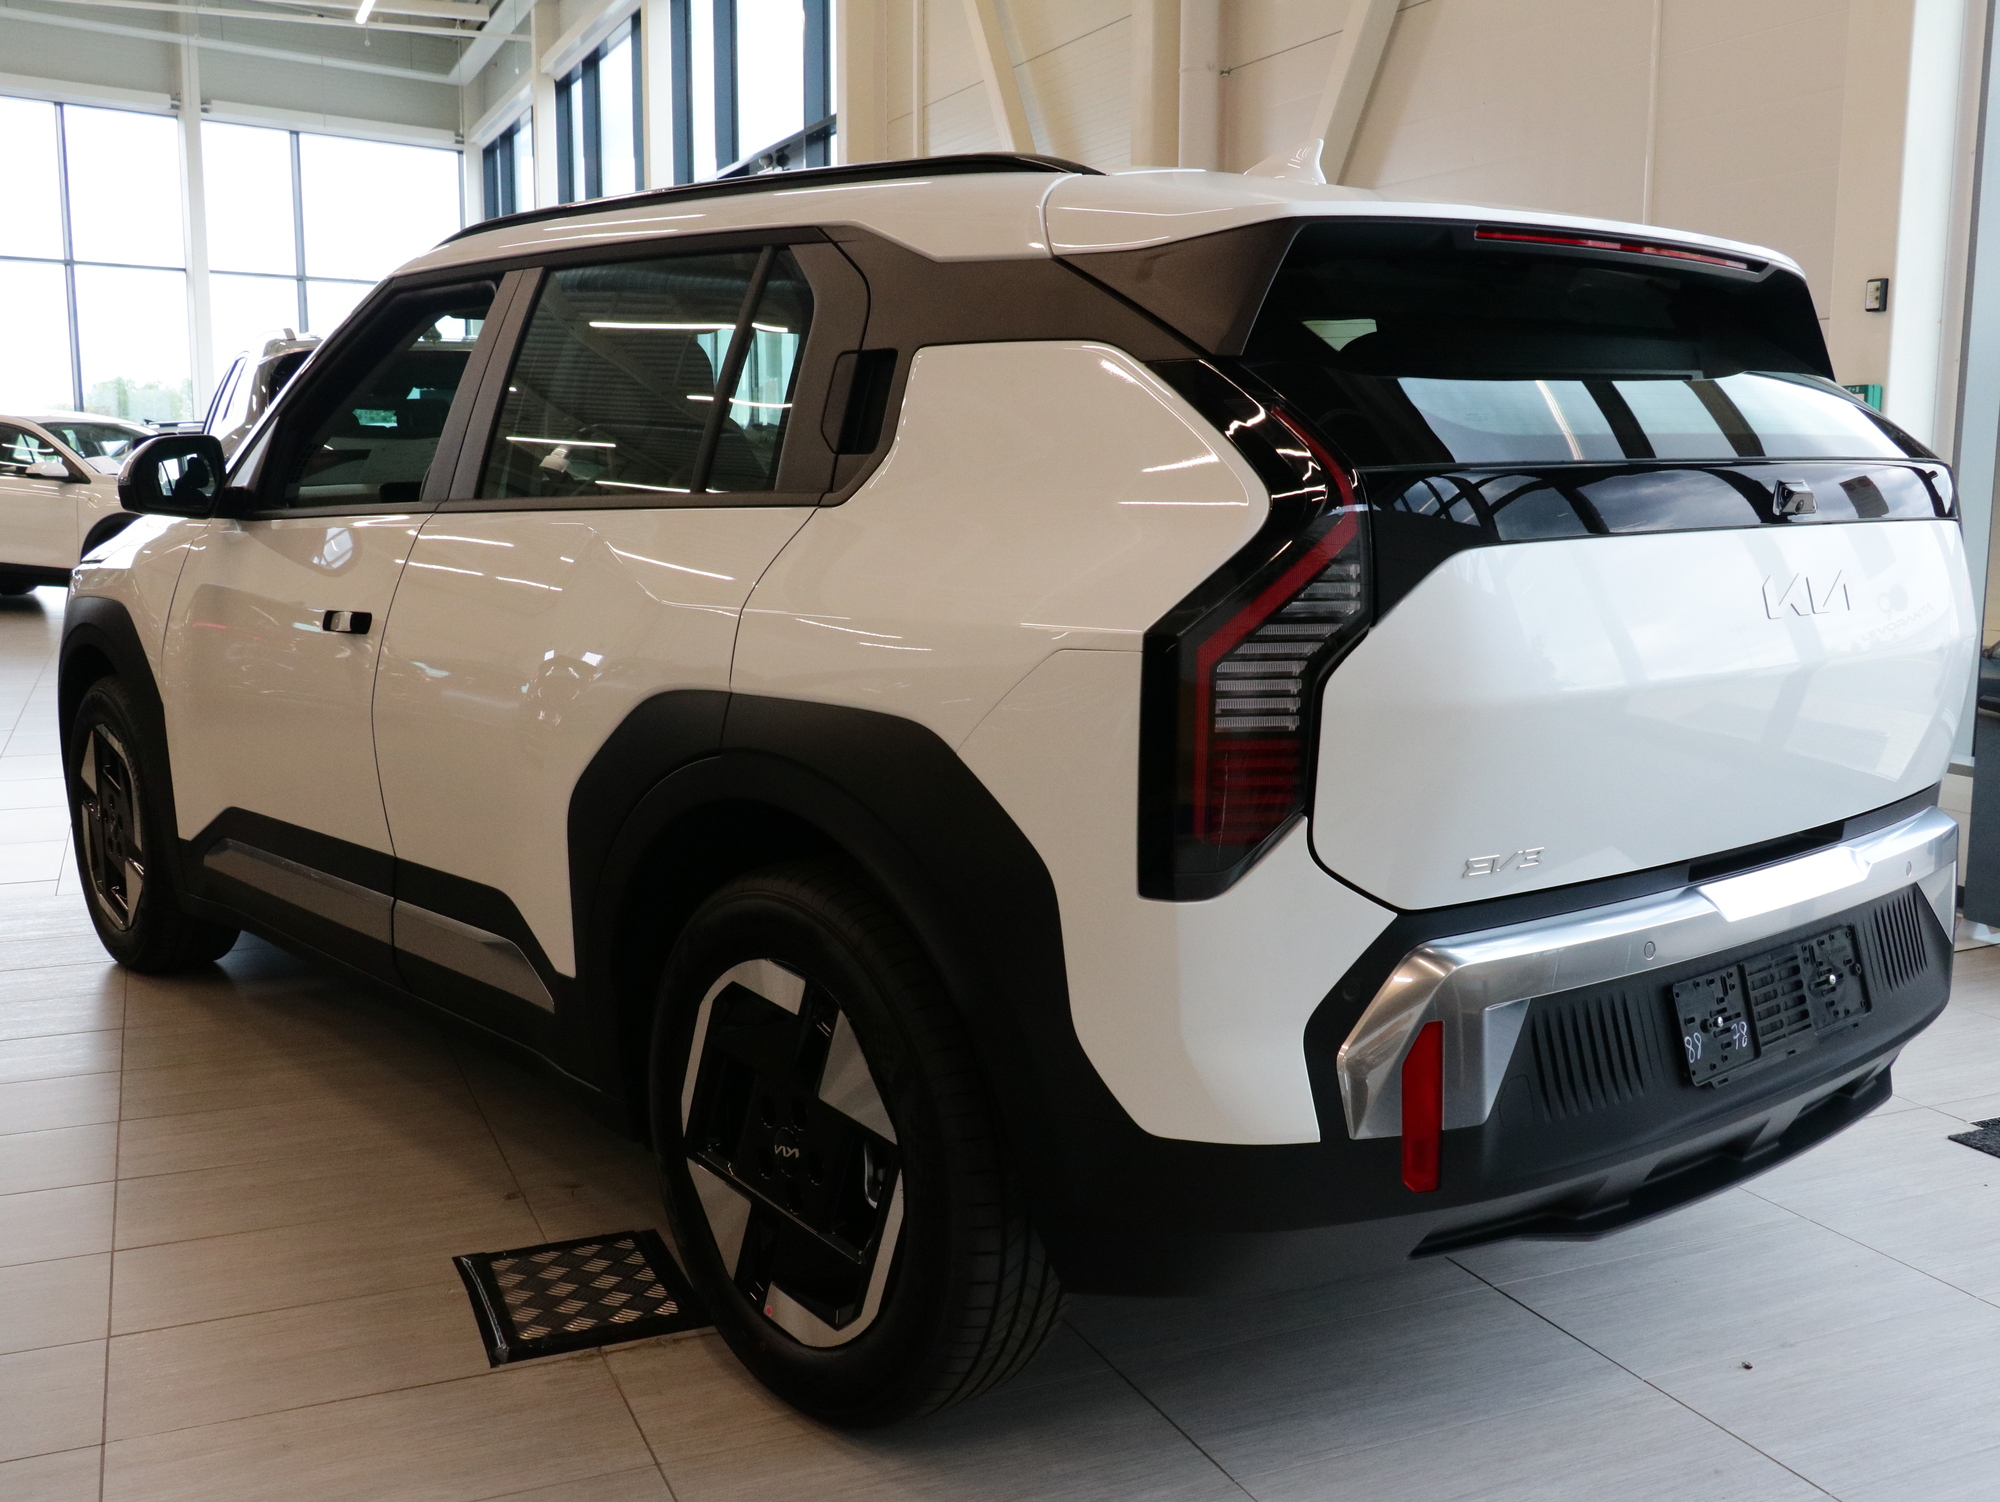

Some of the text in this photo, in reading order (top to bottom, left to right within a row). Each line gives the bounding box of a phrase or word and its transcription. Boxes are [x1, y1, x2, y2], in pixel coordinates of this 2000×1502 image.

[1761, 568, 1851, 620] KIA
[1860, 602, 1934, 642] LEVORANTA
[1461, 846, 1545, 878] EV3
[1731, 1020, 1748, 1051] 78
[774, 1144, 800, 1159] KIA
